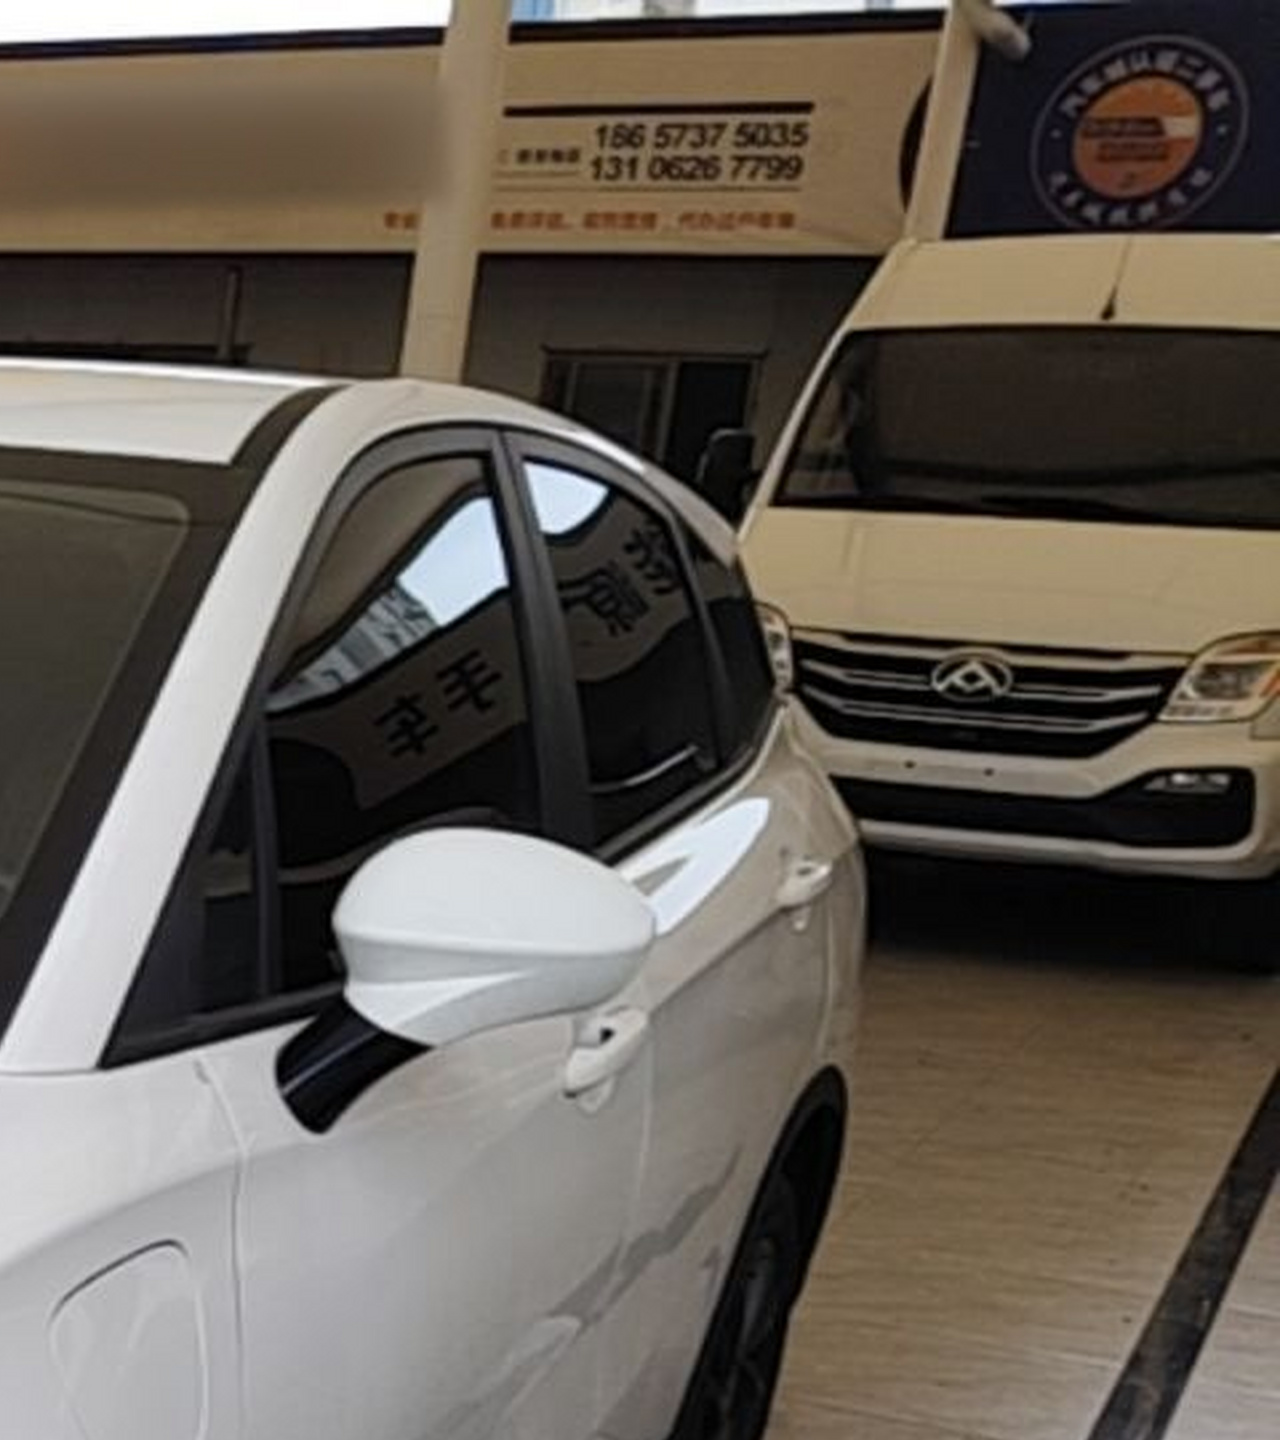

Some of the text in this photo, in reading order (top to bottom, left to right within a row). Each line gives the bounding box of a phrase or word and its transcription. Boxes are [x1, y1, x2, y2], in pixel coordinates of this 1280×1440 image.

[653, 122, 728, 148] 5737
[732, 121, 810, 147] 5035
[591, 155, 639, 180] 131
[646, 155, 722, 181] 0626
[728, 153, 805, 181] 7799
